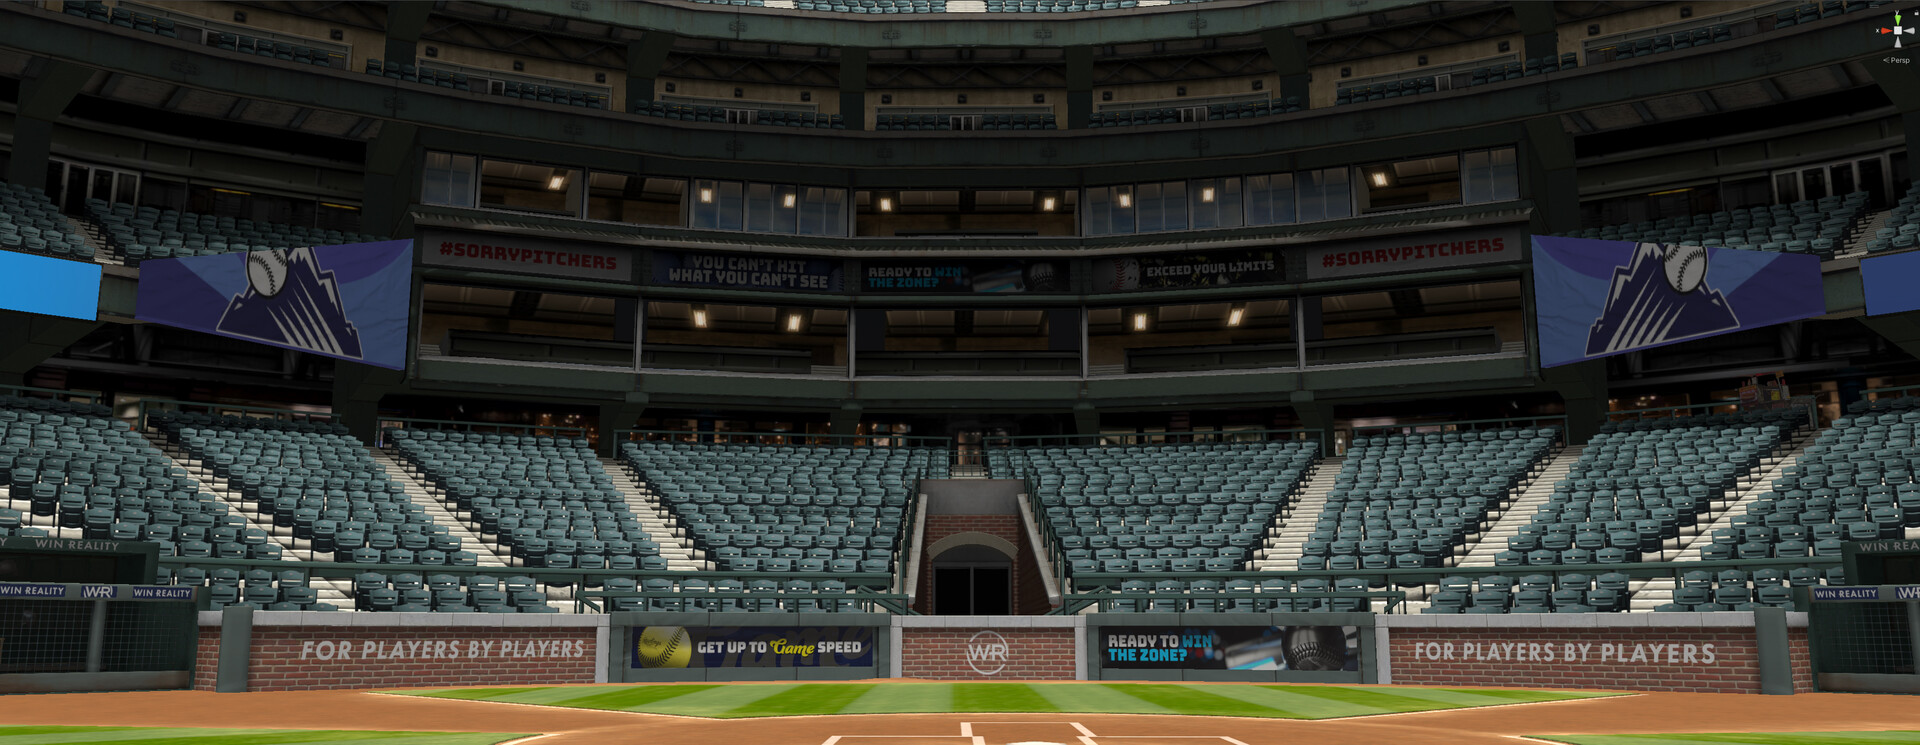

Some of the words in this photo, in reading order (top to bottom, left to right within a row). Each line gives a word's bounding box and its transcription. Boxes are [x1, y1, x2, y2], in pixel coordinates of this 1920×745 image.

[440, 242, 617, 270] #SORRYPITCHERS
[1322, 237, 1505, 268] #SORRYPITCHERS
[692, 255, 725, 270] YOU
[728, 257, 774, 272] CAN'T
[778, 259, 807, 274] HIT
[1147, 264, 1192, 277] EXCEED
[1194, 262, 1226, 275] YOUR
[1229, 259, 1275, 273] LIMITS
[669, 268, 714, 283] WHAT
[715, 270, 748, 285] YOU
[751, 272, 797, 287] CAN'T
[800, 275, 829, 289] SEE
[868, 267, 912, 277] READY
[916, 267, 932, 277] TO
[935, 267, 962, 277] WIN
[869, 278, 894, 288] THE
[897, 278, 940, 288] ZONE?
[35, 539, 64, 549] WIN
[68, 540, 120, 551] REALITY
[1860, 543, 1888, 552] WIN
[0, 586, 22, 595] WIN
[25, 586, 65, 595] REALITY
[134, 589, 153, 597] WIN
[155, 590, 191, 598] REALITY
[1815, 590, 1836, 598] WIN
[1838, 589, 1877, 598] REALITY
[698, 641, 725, 654] GET
[727, 641, 747, 654] UP
[748, 641, 767, 654] TO
[770, 638, 815, 657] Game
[817, 641, 862, 654] SPEED
[1108, 634, 1158, 648] READY
[1160, 634, 1179, 648] TO
[1181, 634, 1212, 648] WIN
[300, 641, 351, 661] FOR
[361, 640, 460, 660] PLAYERS
[467, 640, 494, 659] BY
[500, 640, 584, 659] PLAYERS
[1108, 648, 1137, 661] THE
[1140, 648, 1188, 662] ZONE?
[1415, 642, 1454, 660] FOR
[1463, 642, 1555, 662] PLAYERS
[1564, 643, 1592, 662] BY
[1601, 643, 1716, 664] PLAYERS
